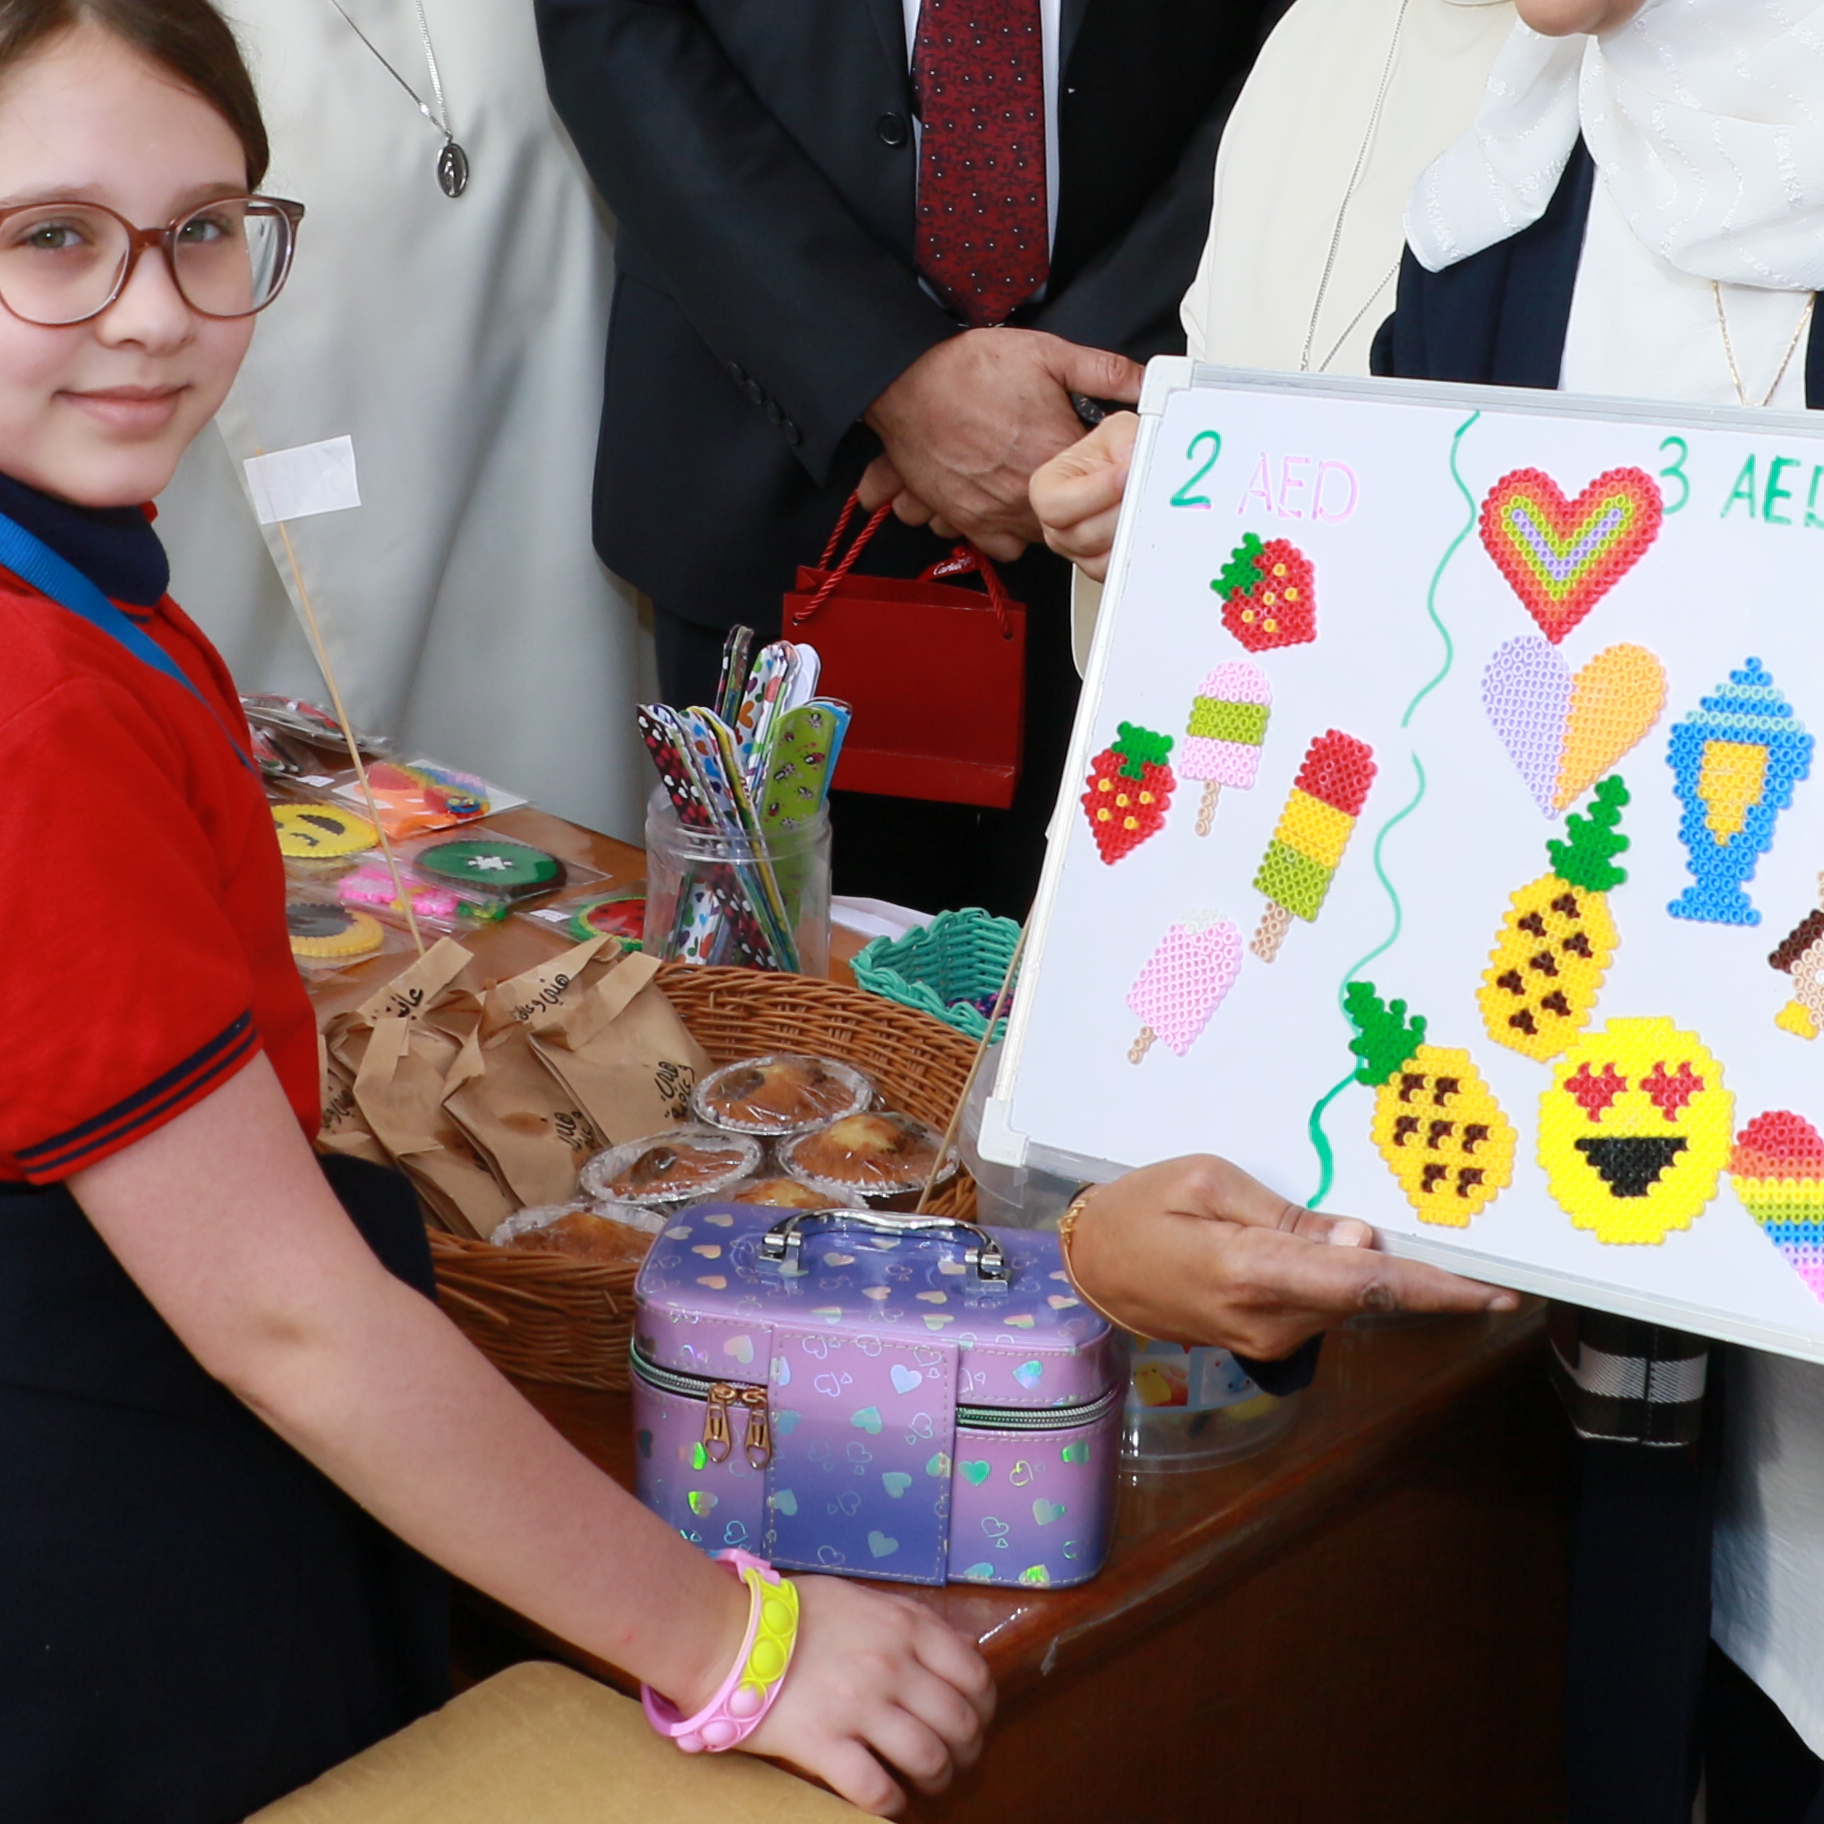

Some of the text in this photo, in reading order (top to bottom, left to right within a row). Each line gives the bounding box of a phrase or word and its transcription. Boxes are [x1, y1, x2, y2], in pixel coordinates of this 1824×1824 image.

[1170, 430, 1360, 524] 2 AED
[1659, 436, 1690, 515] 3
